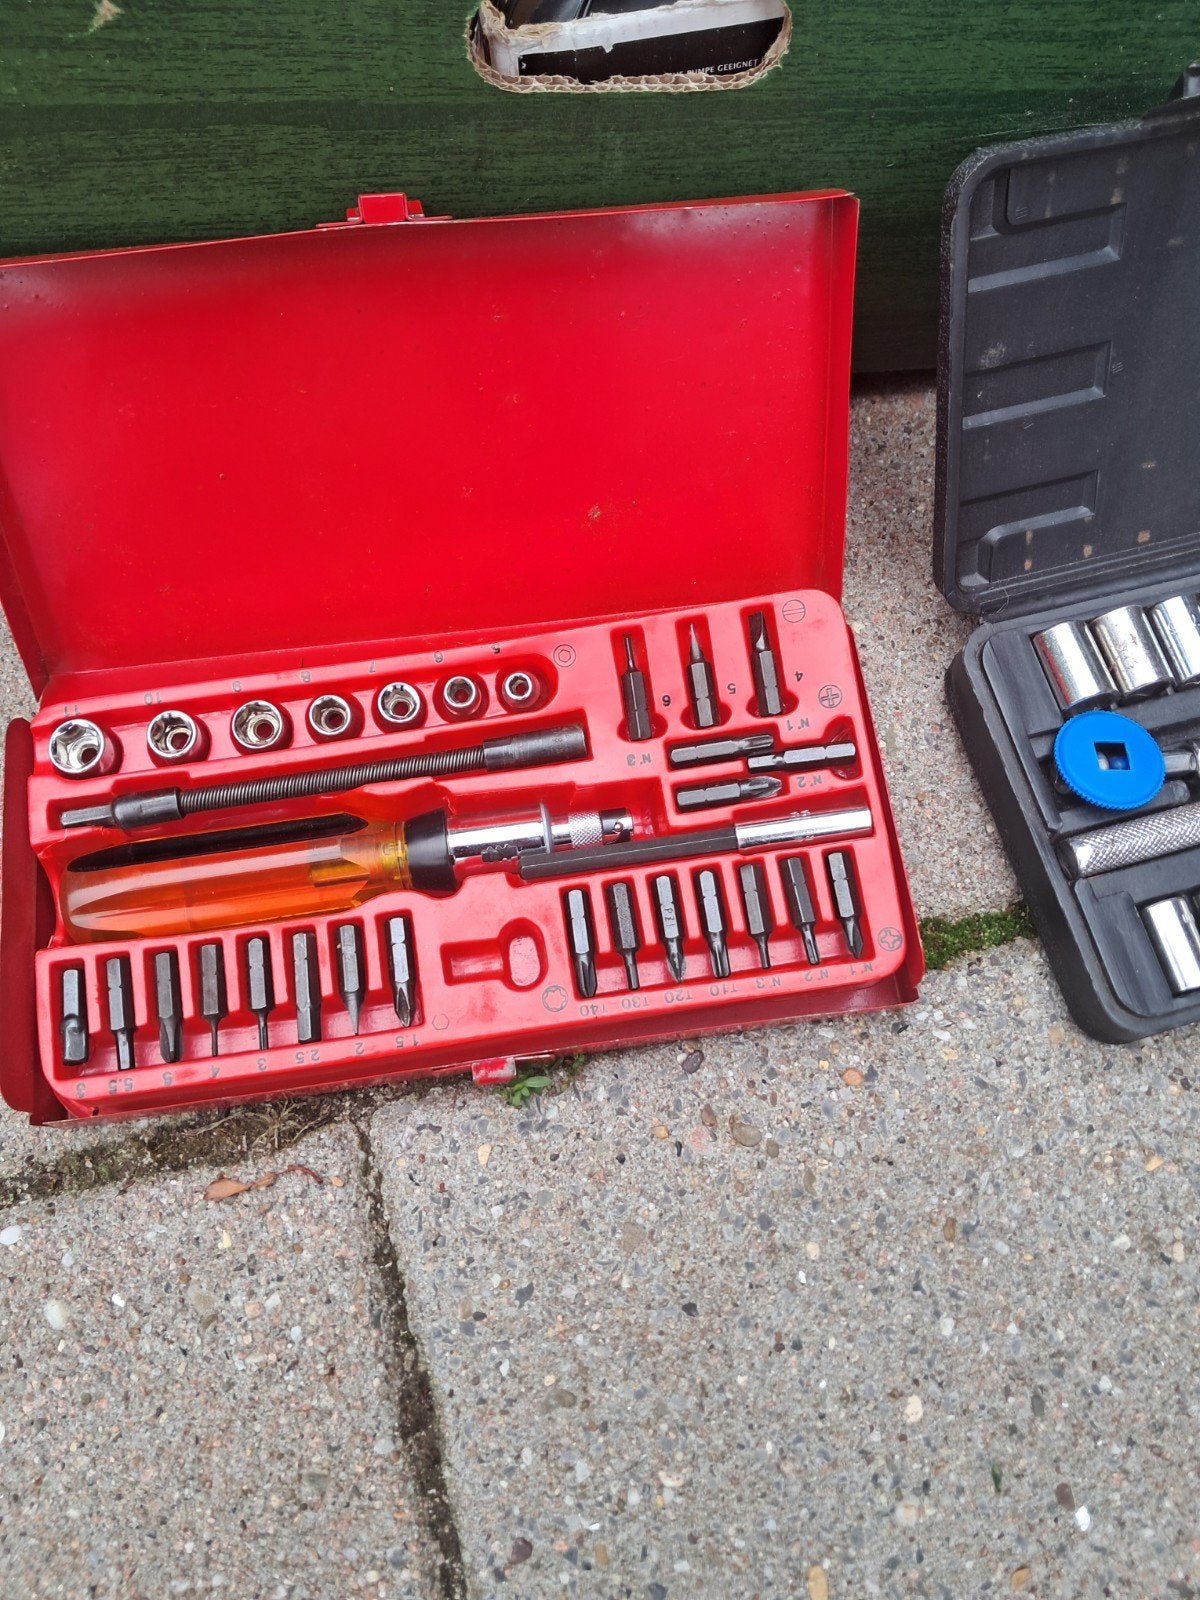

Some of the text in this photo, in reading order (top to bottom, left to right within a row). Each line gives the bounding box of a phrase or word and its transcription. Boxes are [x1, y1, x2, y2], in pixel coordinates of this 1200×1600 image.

[717, 59, 758, 71] GEEIGNET
[434, 651, 443, 663] 6
[301, 671, 311, 683] 8
[795, 672, 804, 681] 4
[728, 683, 736, 694] 5
[144, 692, 162, 705] 10
[663, 696, 671, 706] 6
[710, 984, 737, 996] T10
[665, 990, 692, 1003] T20
[622, 997, 649, 1009] T30
[579, 1004, 608, 1016] T40
[396, 1035, 419, 1047] 1.5
[356, 1042, 364, 1054] 2
[295, 1049, 319, 1063] 2.5
[258, 1058, 266, 1071] 3
[211, 1065, 219, 1078] 4
[108, 1078, 133, 1095] 5.5
